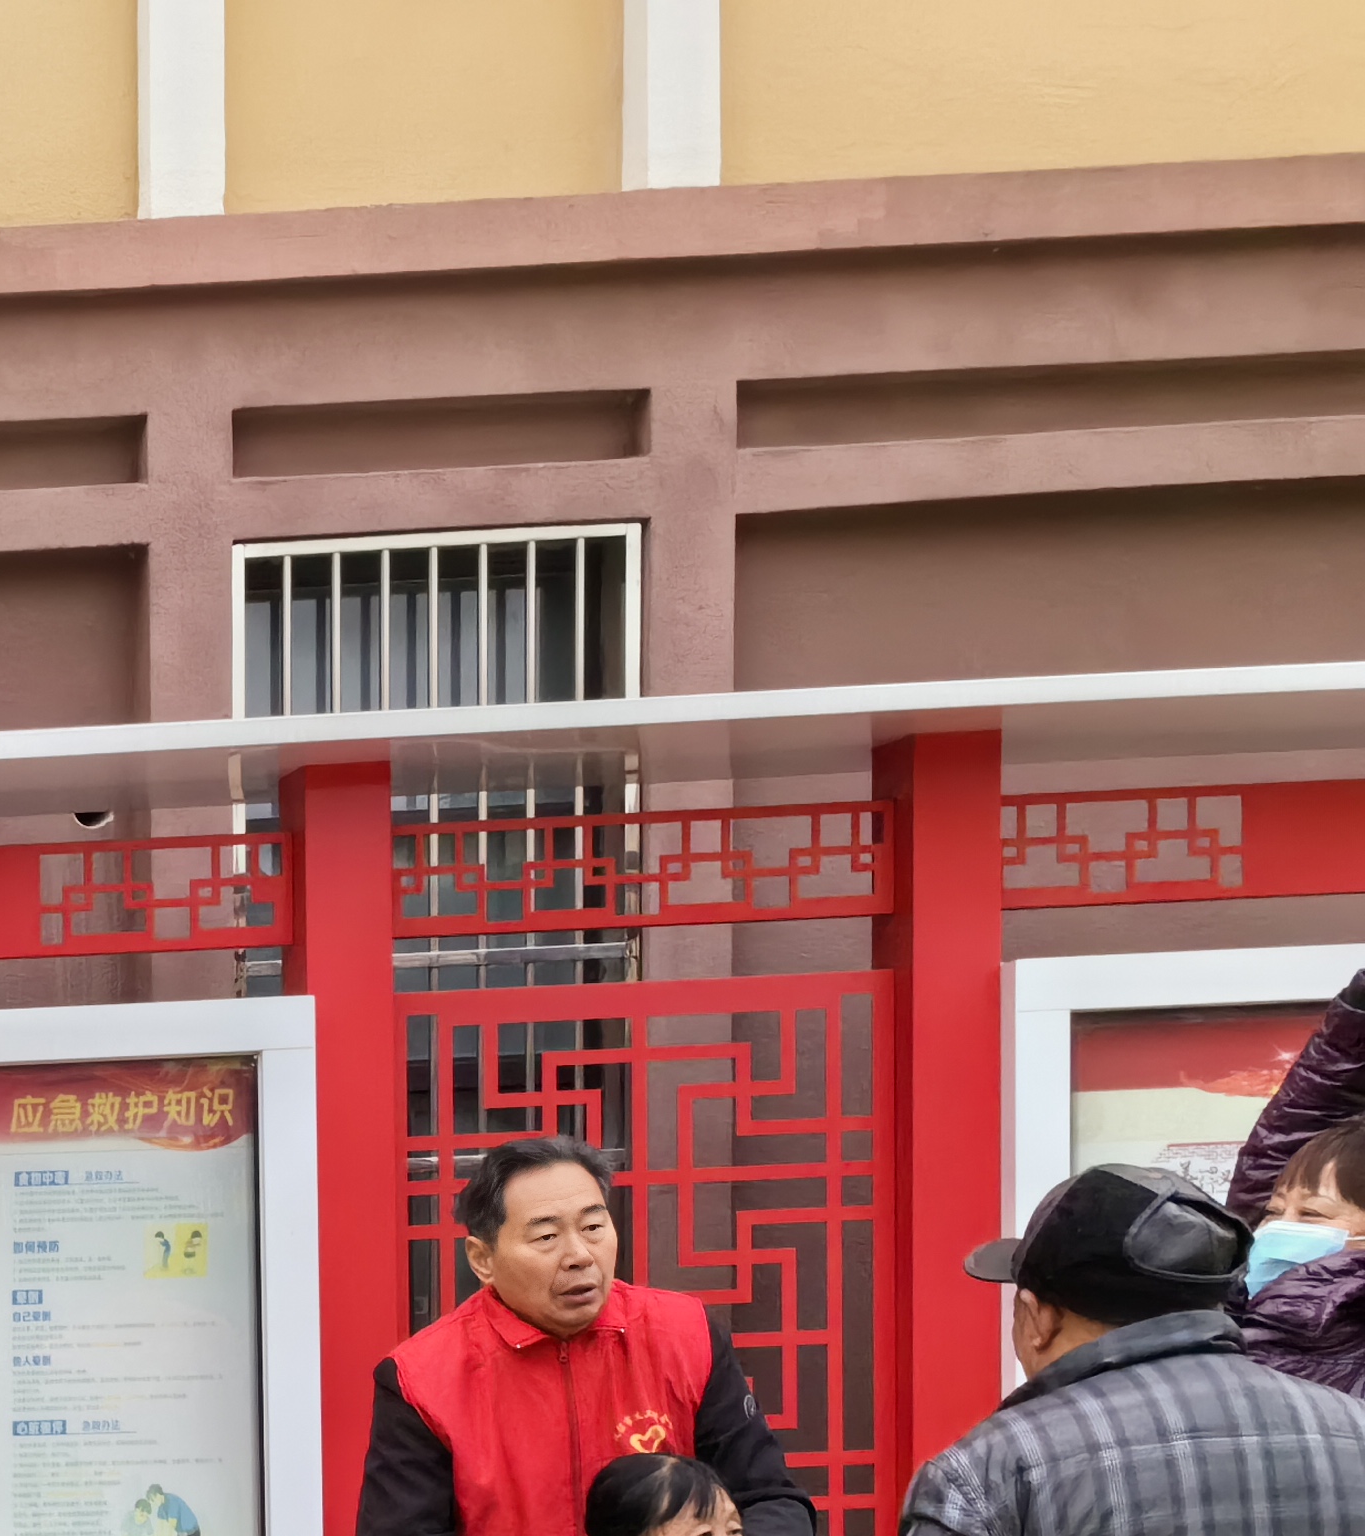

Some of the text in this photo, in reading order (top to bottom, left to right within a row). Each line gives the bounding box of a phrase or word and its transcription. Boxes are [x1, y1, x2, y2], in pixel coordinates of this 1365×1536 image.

[10, 1087, 234, 1134] 应急救护知识
